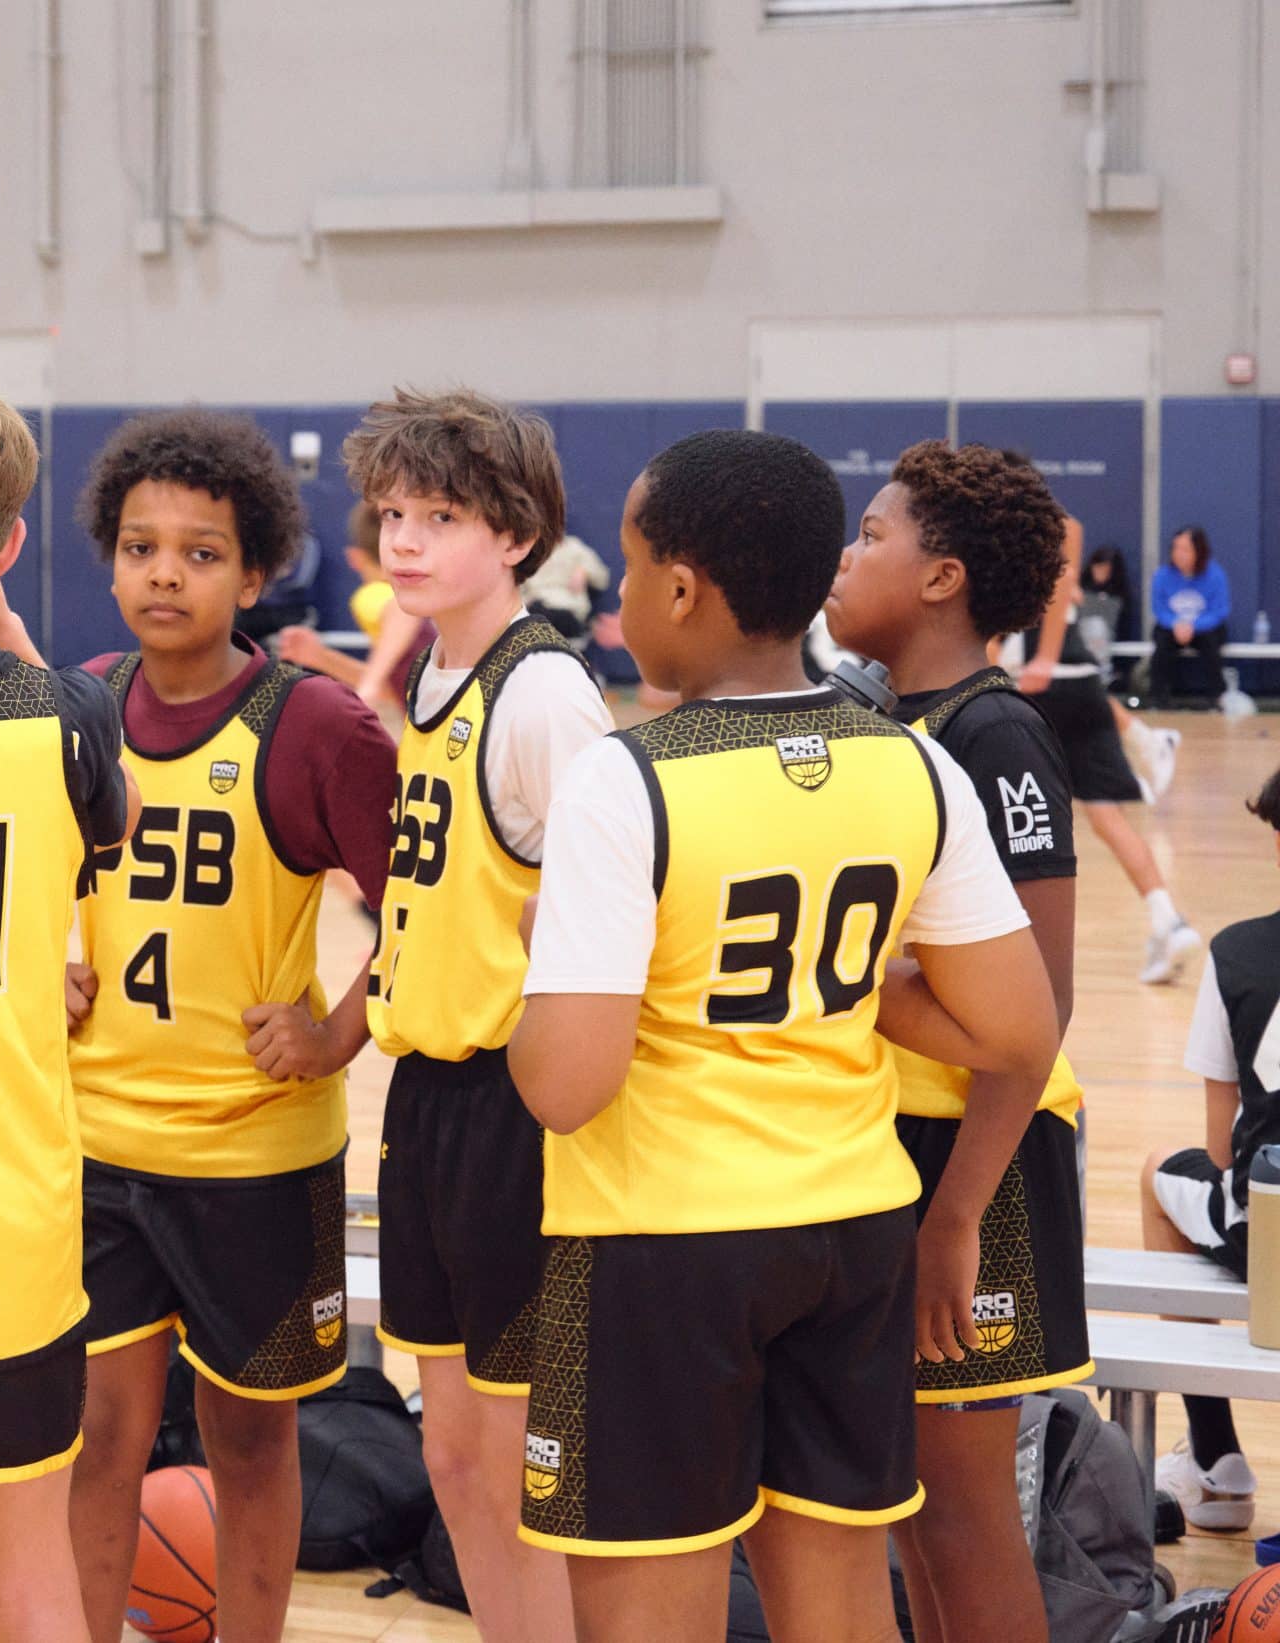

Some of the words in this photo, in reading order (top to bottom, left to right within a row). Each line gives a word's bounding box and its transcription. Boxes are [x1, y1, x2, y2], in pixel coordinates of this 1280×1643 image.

[775, 734, 825, 753] PRO
[780, 747, 827, 761] SKILLS
[1008, 833, 1054, 854] HOOPS
[703, 860, 902, 1028] 30
[123, 930, 174, 1023] 4
[312, 1291, 343, 1315] PRO
[973, 1292, 1014, 1311] RO
[972, 1308, 1016, 1321] KILLS
